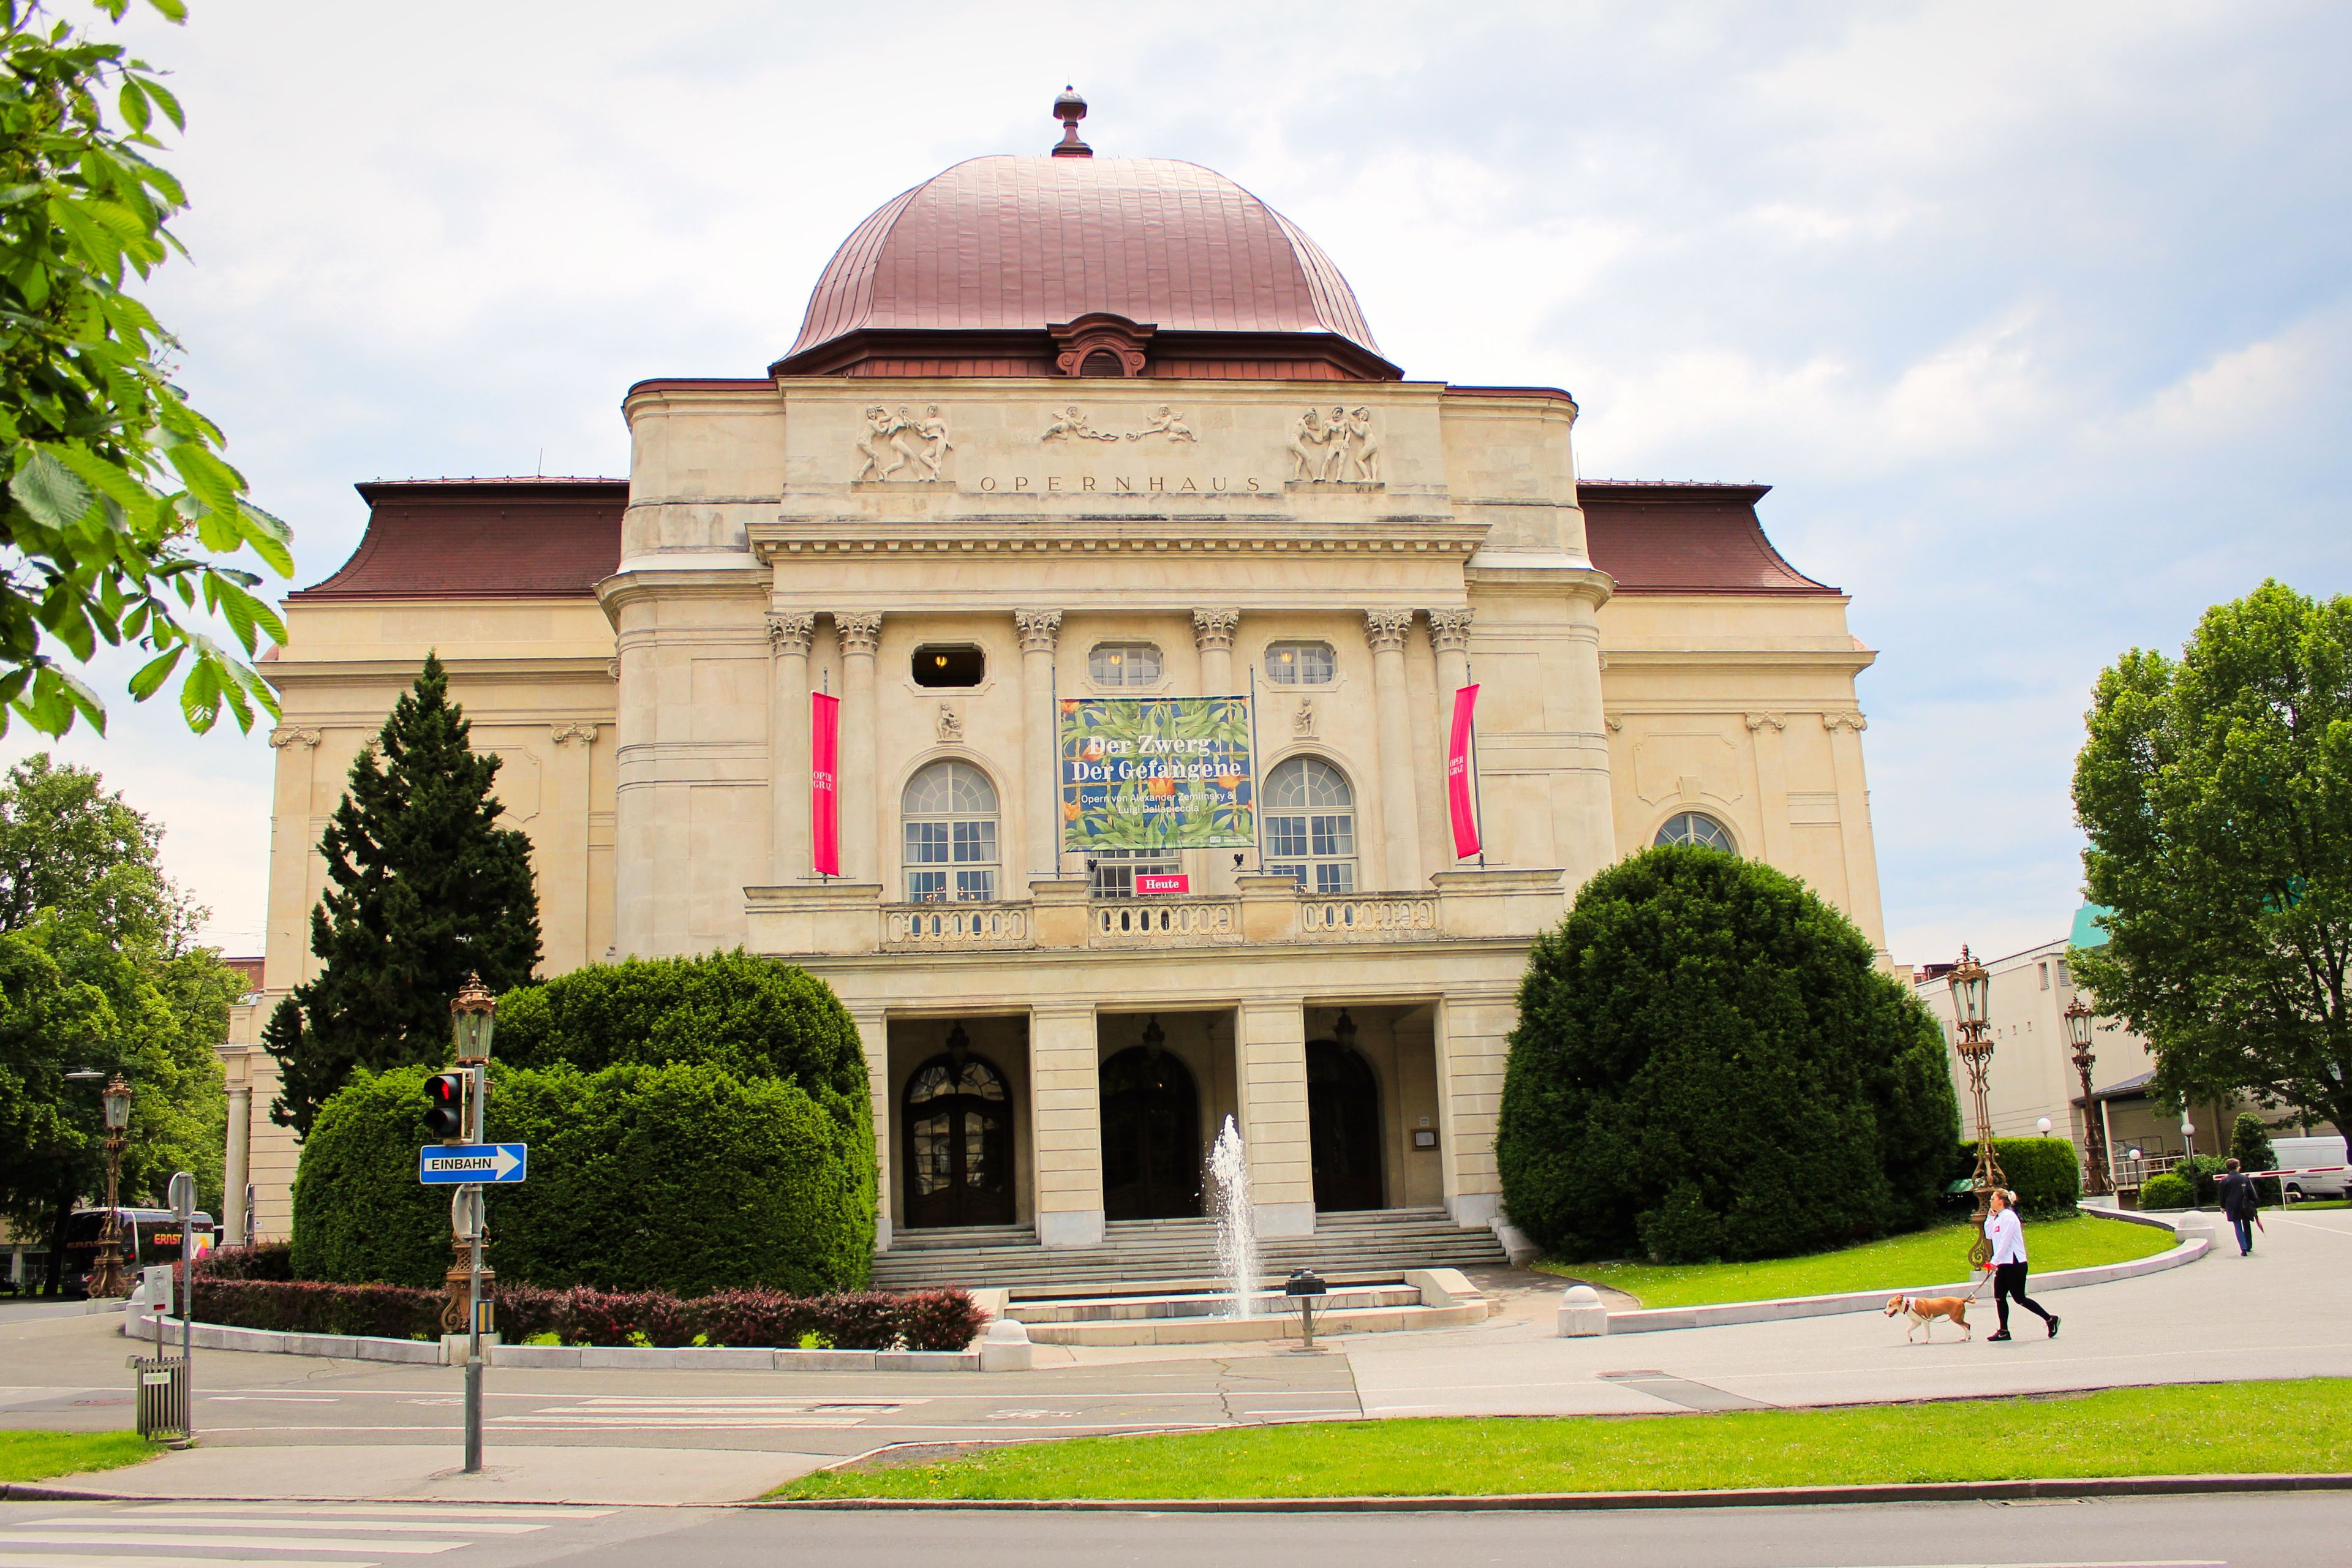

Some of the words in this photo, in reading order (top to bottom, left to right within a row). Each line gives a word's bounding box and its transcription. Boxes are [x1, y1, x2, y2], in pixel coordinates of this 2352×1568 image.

[980, 477, 1259, 491] OPERNHAUS
[1087, 736, 1131, 755] Der
[1138, 735, 1212, 757] Zwerg
[1449, 756, 1463, 767] OPER
[813, 771, 832, 783] OPER
[1071, 762, 1114, 780] Der
[1118, 760, 1242, 783] Gefangene
[1081, 794, 1109, 805] Opern
[1130, 793, 1175, 802] Alexander
[1178, 793, 1225, 802] Zemlinsky
[1118, 805, 1140, 815] Luigi
[1142, 804, 1200, 815] Dallapiccola
[1145, 879, 1179, 889] Heute
[431, 1158, 491, 1170] EINBAHN
[66, 1240, 101, 1249] ERNS
[154, 1234, 183, 1245] ERNST
